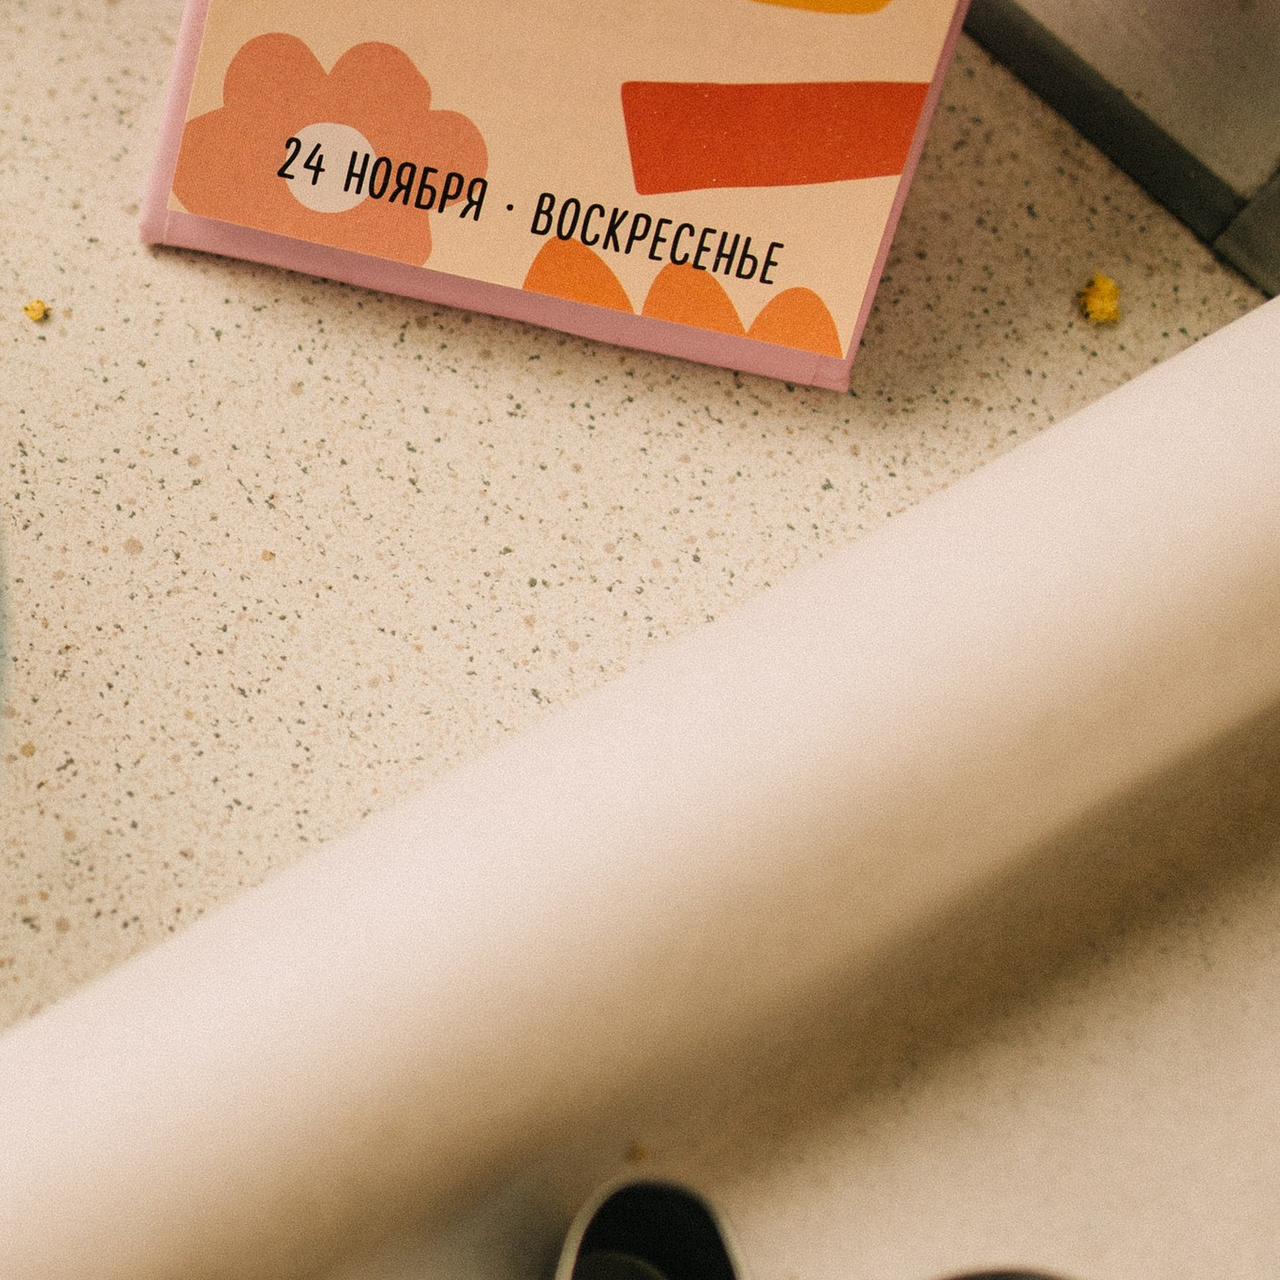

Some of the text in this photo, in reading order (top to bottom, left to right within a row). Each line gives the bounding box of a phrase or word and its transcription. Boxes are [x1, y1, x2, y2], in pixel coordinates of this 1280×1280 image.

[276, 136, 326, 186] 24
[343, 150, 489, 222] НОЯБРЯ
[530, 192, 786, 286] ВОСКРЕСЕНЬЕ
